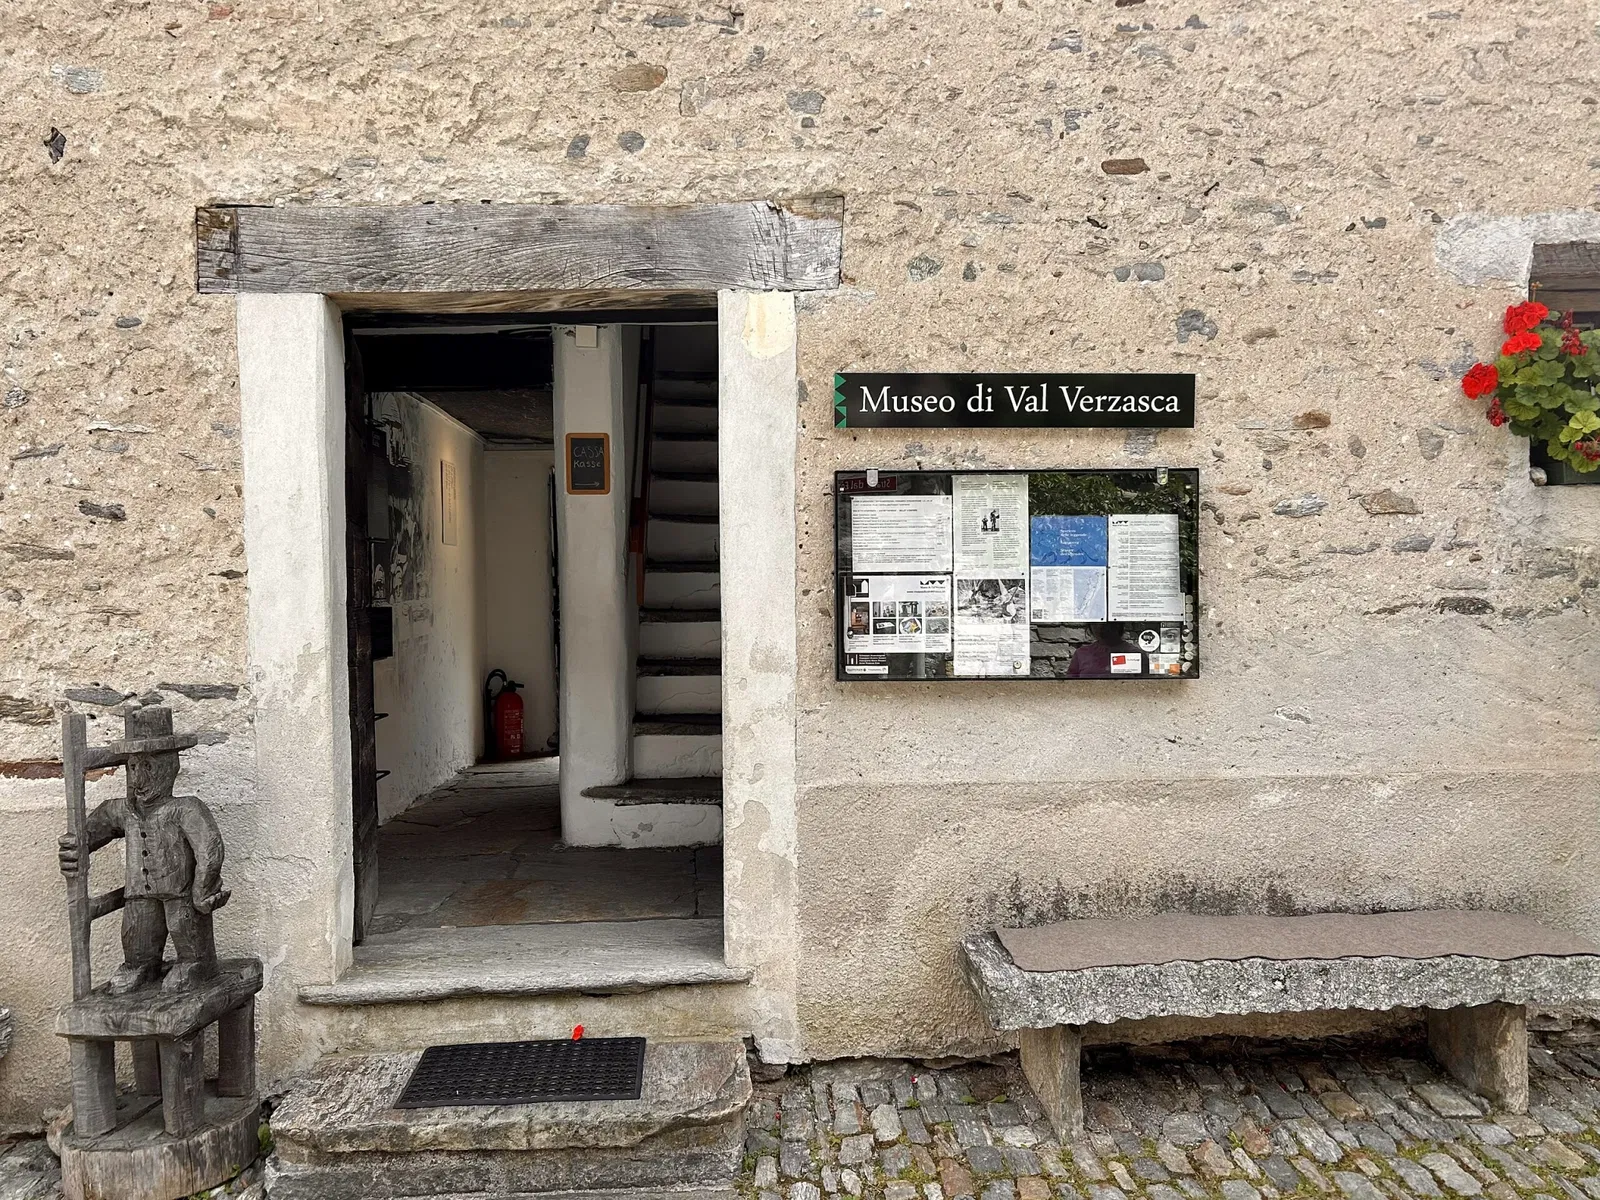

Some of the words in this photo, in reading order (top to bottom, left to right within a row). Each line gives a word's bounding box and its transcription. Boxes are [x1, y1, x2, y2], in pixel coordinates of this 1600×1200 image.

[859, 385, 956, 413] Museo
[966, 383, 995, 413] di
[1004, 383, 1050, 413] Val
[1058, 385, 1181, 413] Verzasca
[573, 446, 604, 459] CASSA
[573, 460, 602, 469] Kasse
